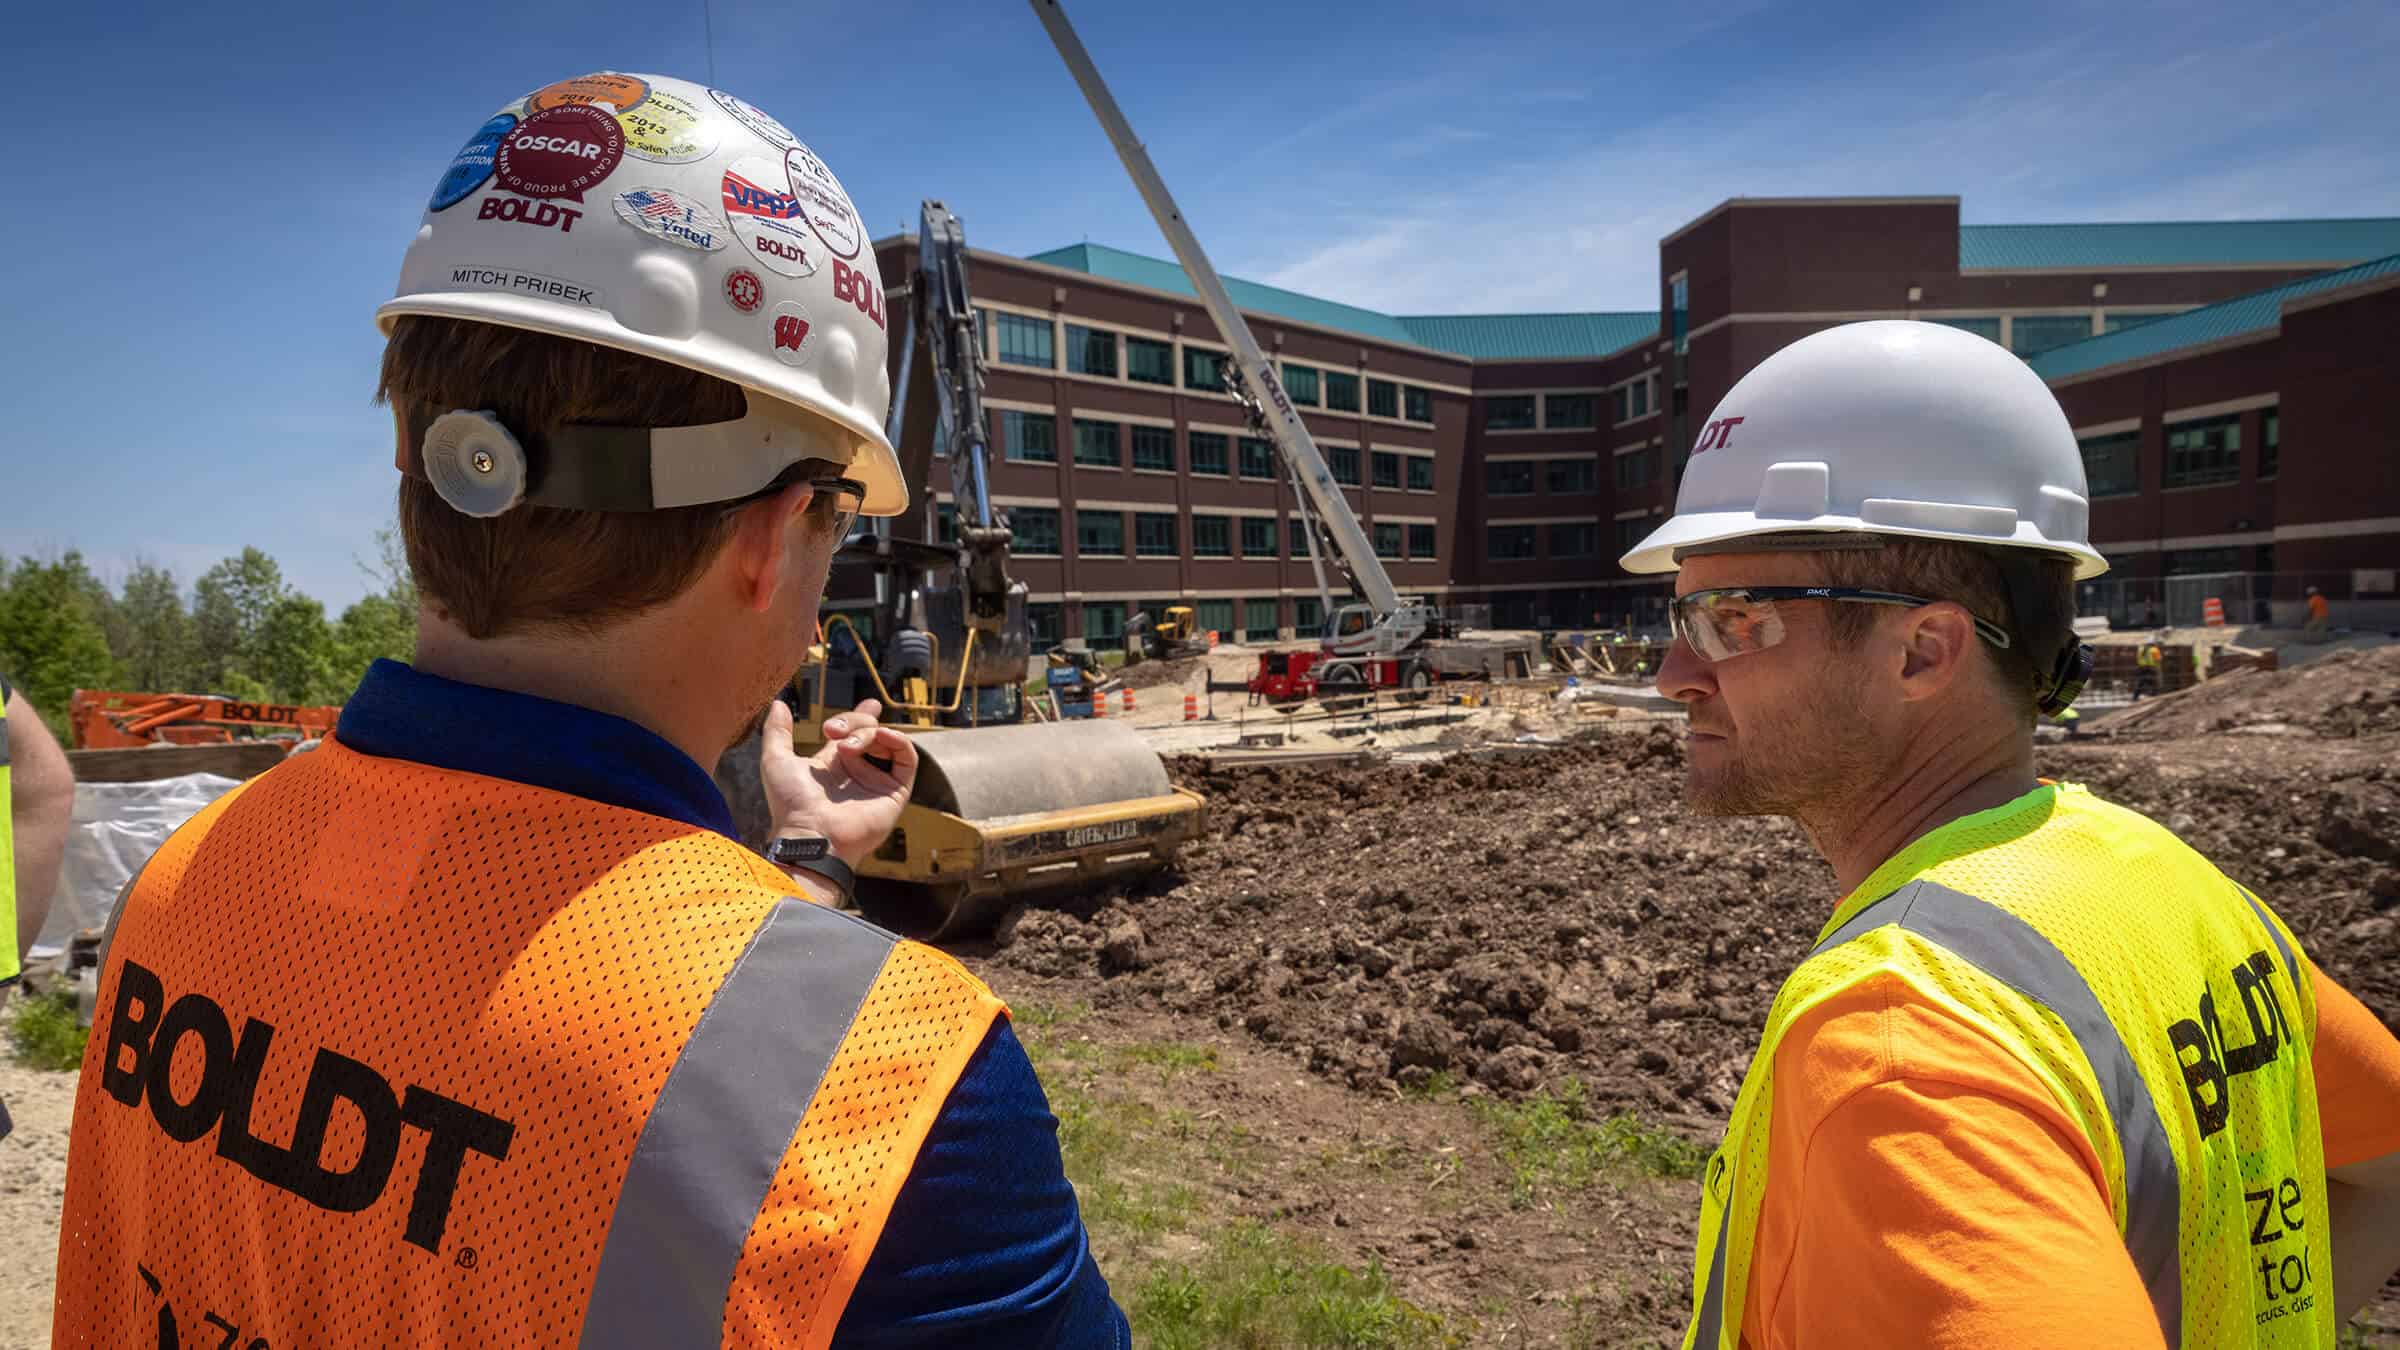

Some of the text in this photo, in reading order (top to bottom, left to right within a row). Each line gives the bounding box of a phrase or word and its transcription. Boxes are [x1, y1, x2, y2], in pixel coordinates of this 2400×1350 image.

[532, 111, 550, 122] DO
[555, 106, 615, 133] SOMETHING
[627, 114, 667, 135] 2013
[508, 123, 527, 140] DAY
[514, 135, 602, 160] OSCAR
[607, 134, 618, 155] YOU
[590, 157, 612, 177] CAN
[507, 175, 521, 186] OF
[523, 183, 567, 193] PROUD
[571, 175, 588, 188] BE
[728, 183, 785, 217] VPP
[478, 197, 583, 233] BOLDT
[660, 215, 712, 248] Voted
[756, 235, 806, 265] BOLDT
[451, 270, 593, 305] MITCH PRIBEK
[1260, 368, 1292, 415] BOLDT
[223, 703, 299, 723] BOLDT
[101, 959, 516, 1256] BOLDT
